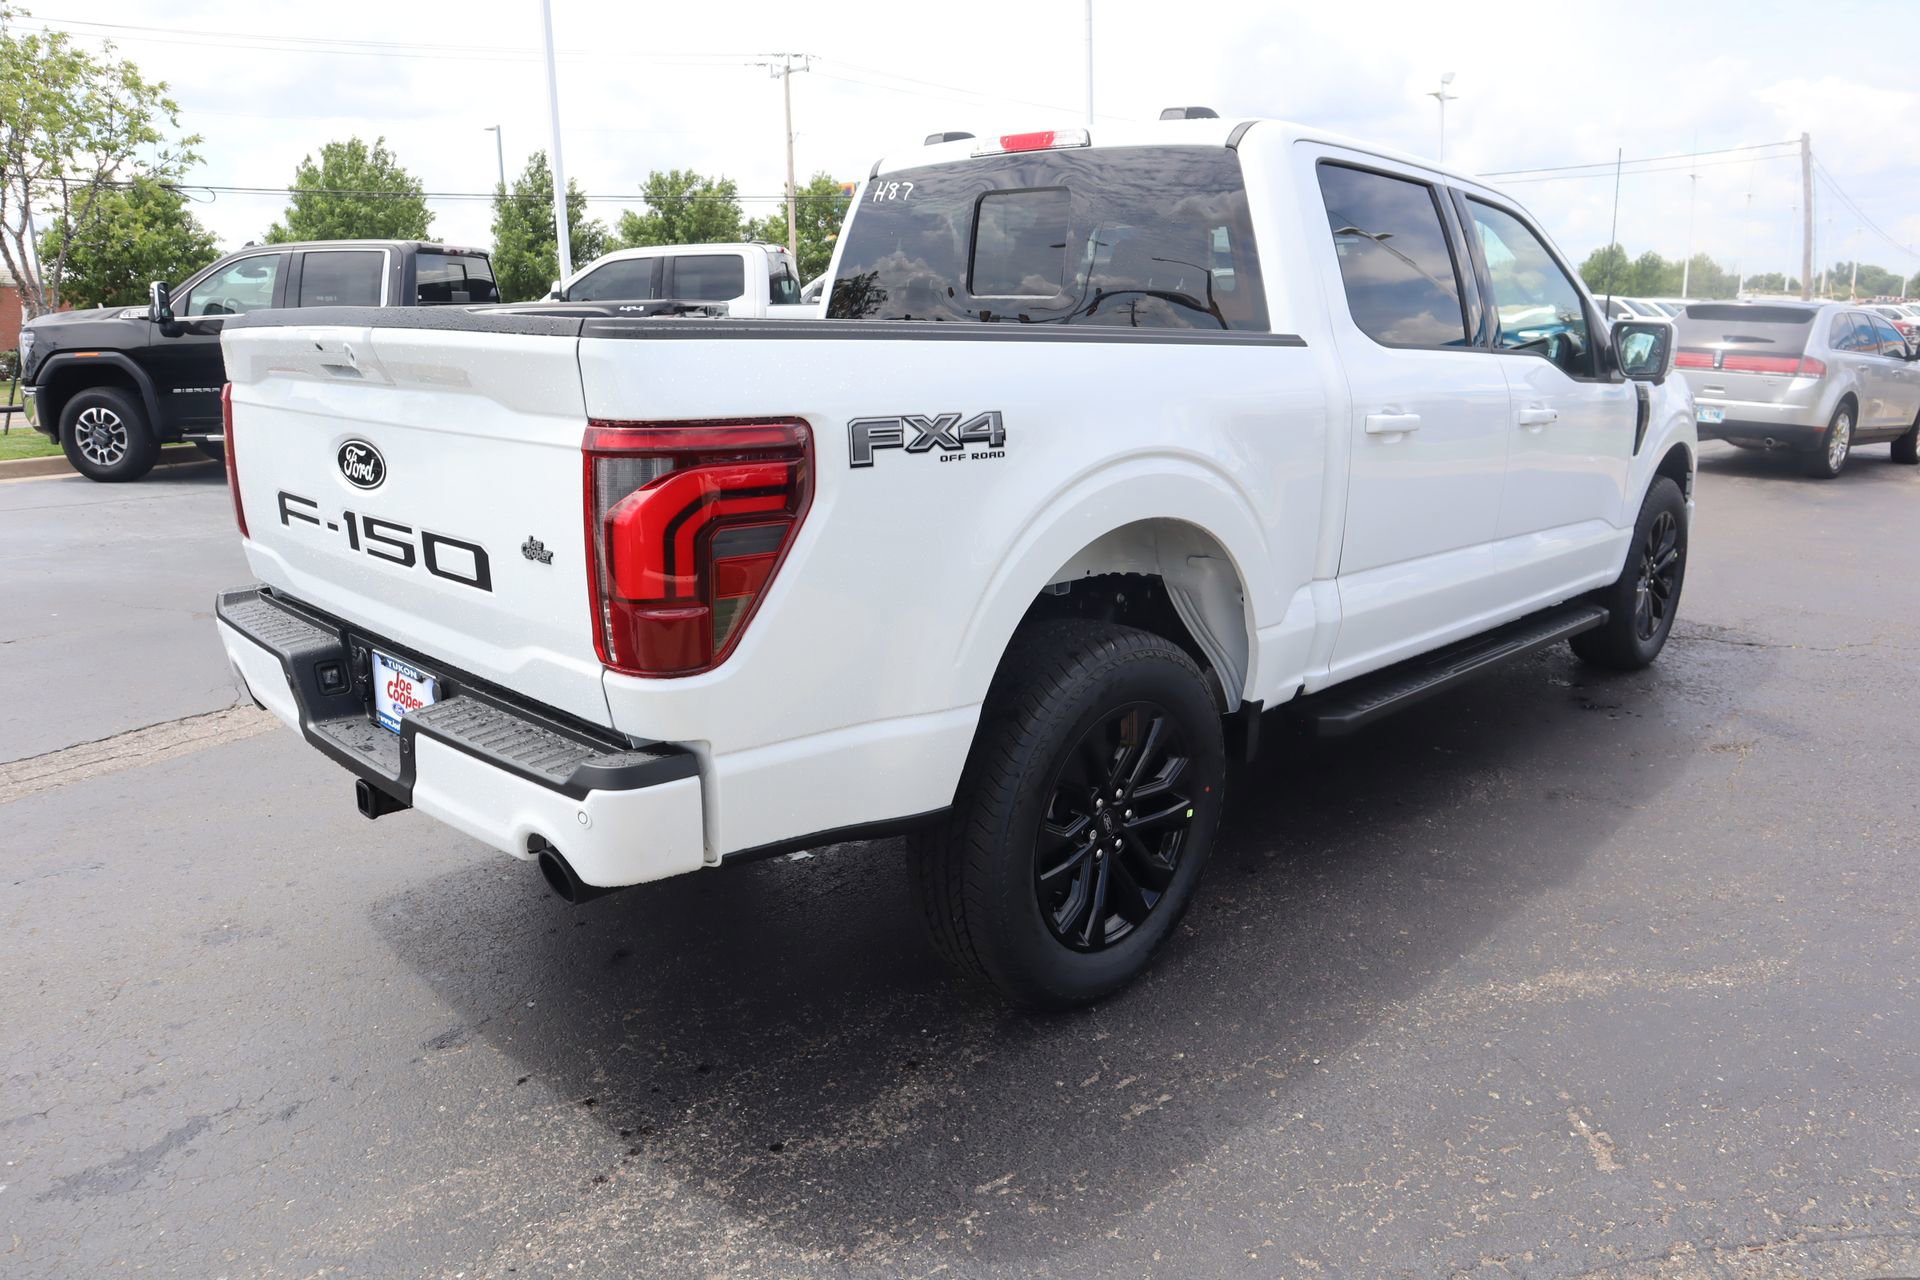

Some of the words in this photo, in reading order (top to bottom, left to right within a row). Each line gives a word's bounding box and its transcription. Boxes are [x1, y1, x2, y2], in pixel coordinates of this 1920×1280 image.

[873, 181, 914, 203] H87
[847, 410, 1006, 469] FX4
[343, 445, 375, 482] Ford
[940, 453, 966, 462] OFF
[971, 451, 1005, 460] ROAD
[277, 490, 493, 592] F-150
[386, 659, 418, 679] YUKON
[387, 680, 424, 710] Cooper
[394, 671, 412, 695] Joe
